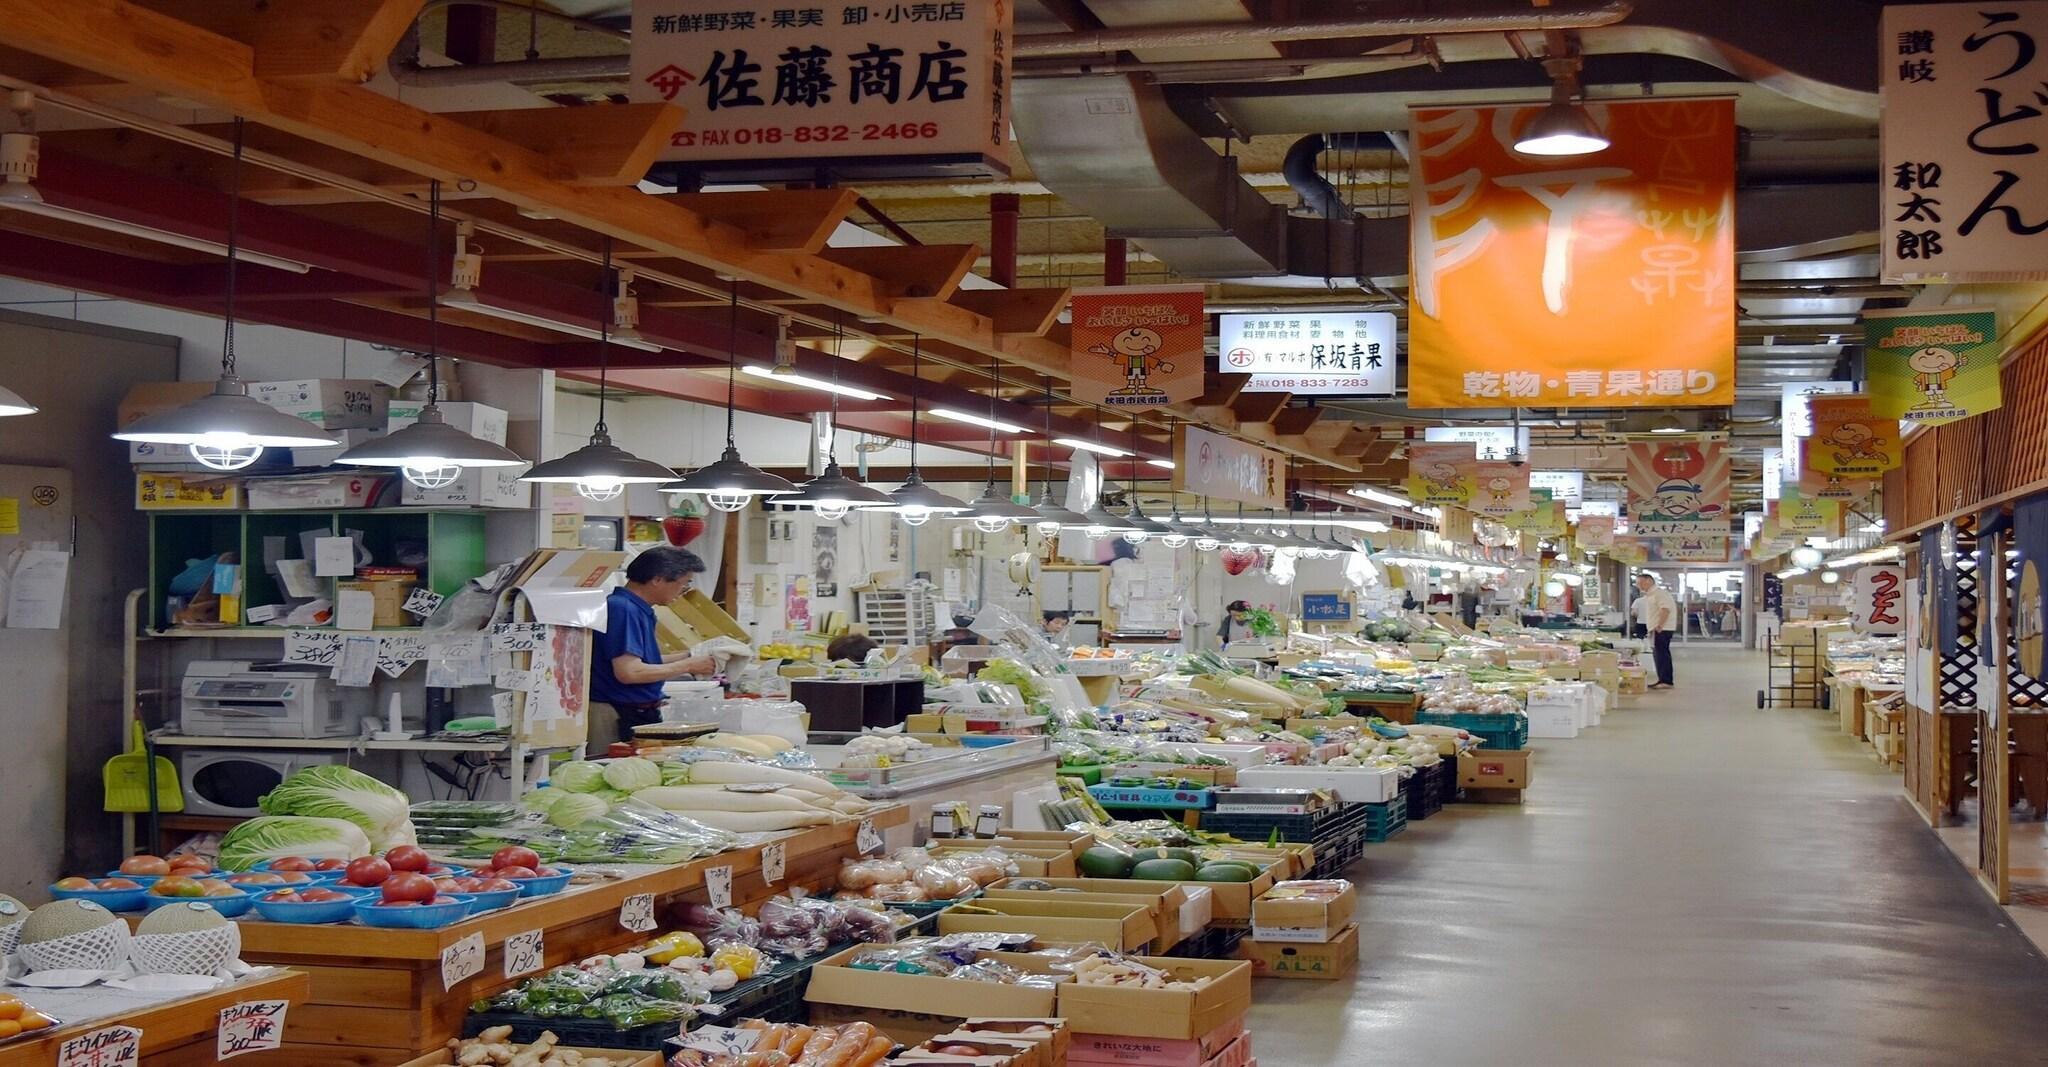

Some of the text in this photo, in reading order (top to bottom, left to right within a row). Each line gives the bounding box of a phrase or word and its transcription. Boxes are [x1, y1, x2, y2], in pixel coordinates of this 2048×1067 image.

[652, 2, 966, 34] 新鮮野菜・果実 卸・小売店
[699, 41, 968, 112] 佐藤商店
[702, 122, 938, 146] FAX 018-832-2466
[1957, 11, 2048, 237] うどん
[1894, 161, 1943, 260] 和太郎
[1243, 320, 1300, 329] 新鮮野菜
[1243, 330, 1300, 339] 料理用食材
[1310, 342, 1383, 371] 保坂青果
[1256, 379, 1369, 388] FAX 018-833-7283
[1462, 369, 1717, 398] 乾物・青果通り
[1869, 571, 1901, 624] うどん
[1094, 1041, 1162, 1053] きれいな大地に
